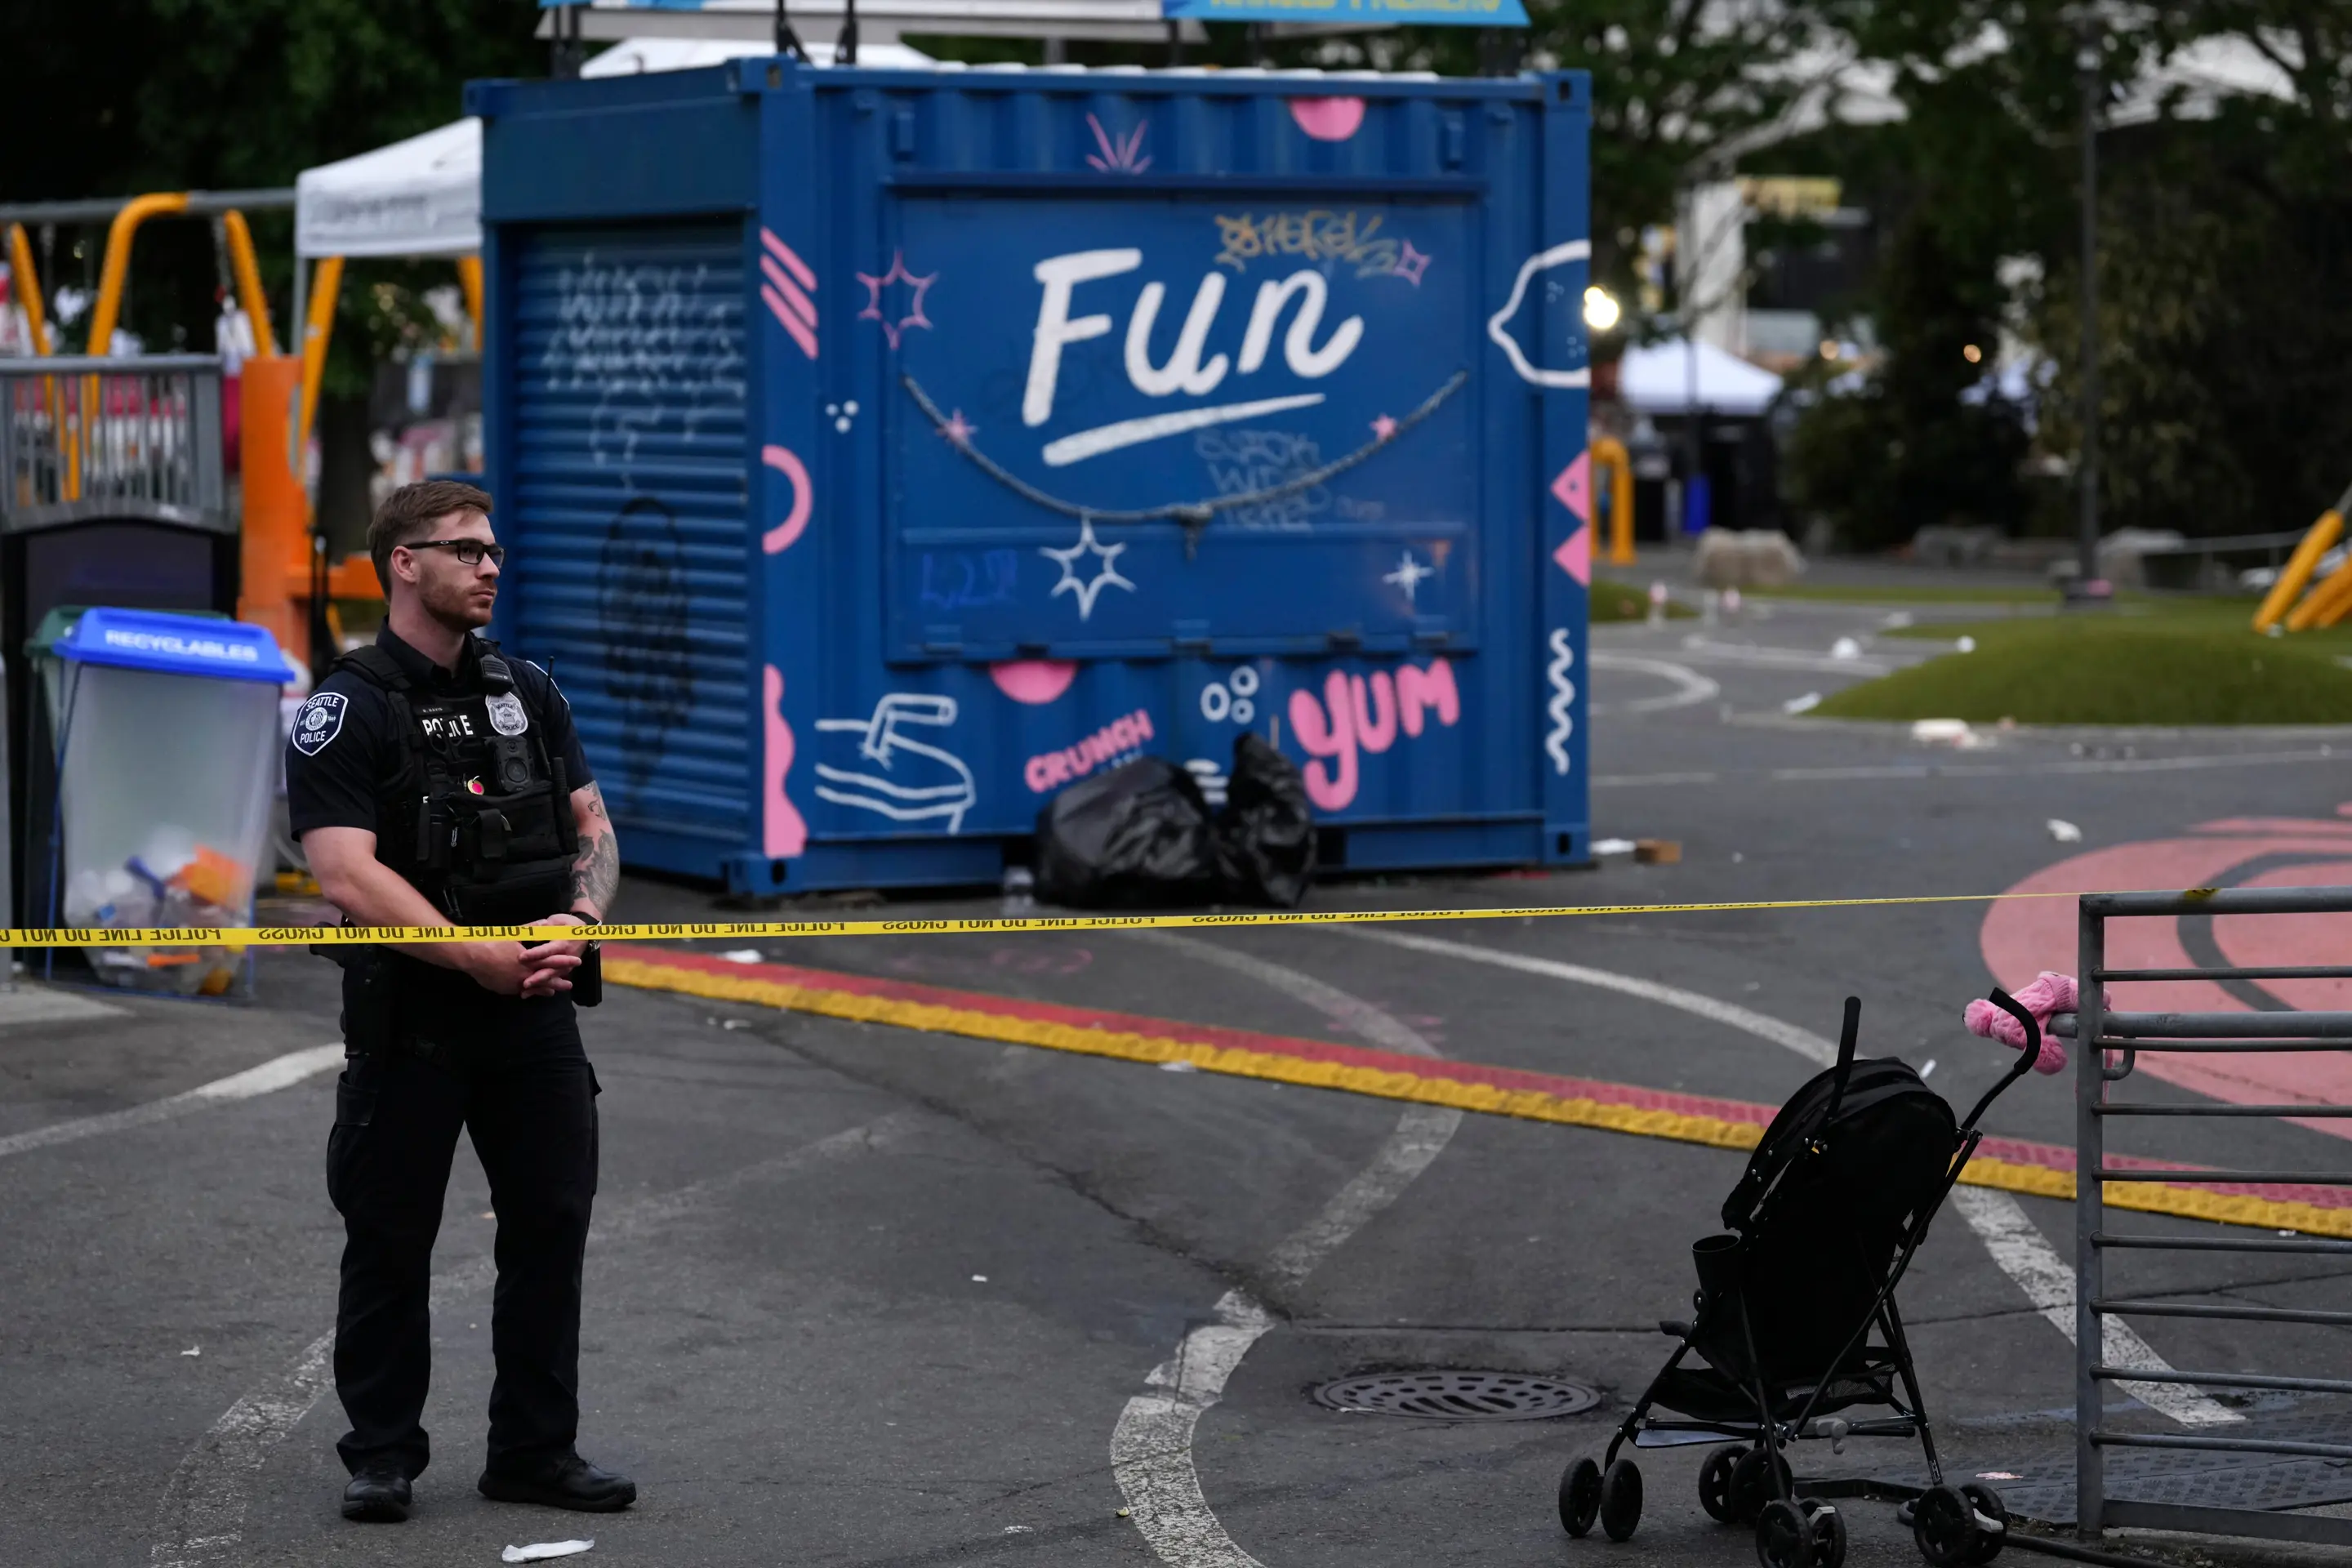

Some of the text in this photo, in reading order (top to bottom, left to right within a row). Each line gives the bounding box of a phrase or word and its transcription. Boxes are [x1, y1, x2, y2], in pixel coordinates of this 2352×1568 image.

[1022, 247, 1364, 427] Fun
[105, 628, 258, 662] RECYCLABLES
[305, 696, 339, 712] SEATTLE
[300, 731, 326, 744] POLICE
[421, 715, 474, 737] POICE
[1024, 708, 1156, 793] CRUNCH
